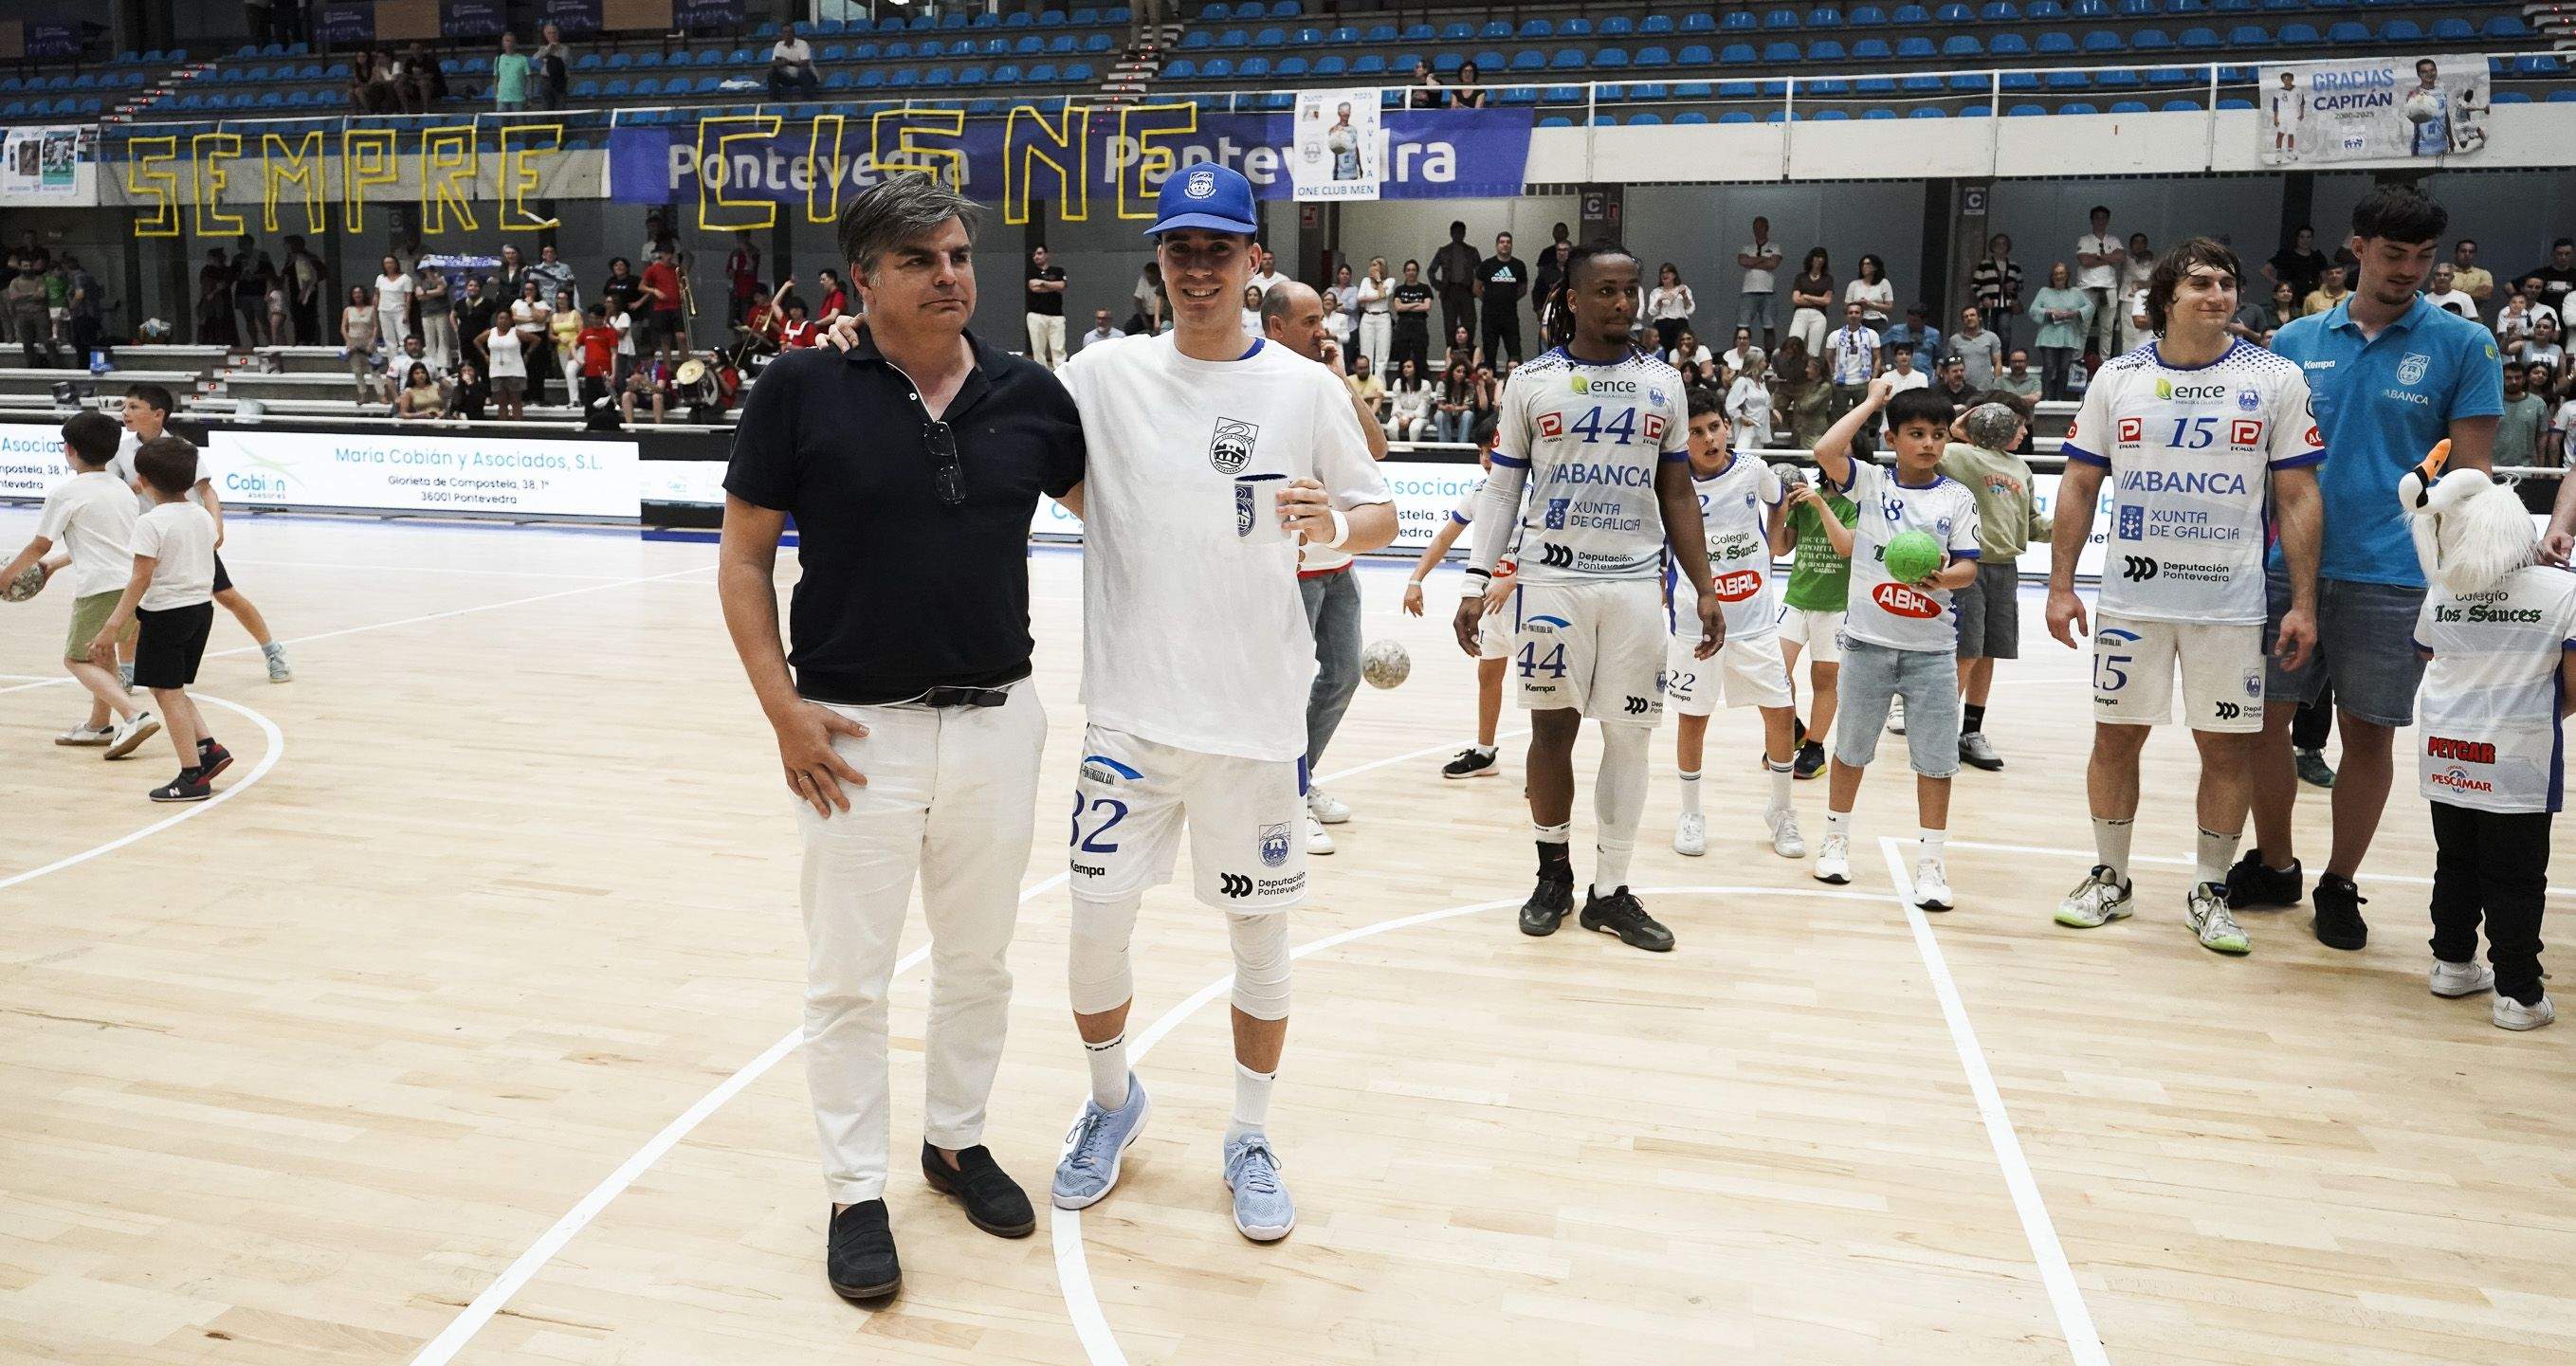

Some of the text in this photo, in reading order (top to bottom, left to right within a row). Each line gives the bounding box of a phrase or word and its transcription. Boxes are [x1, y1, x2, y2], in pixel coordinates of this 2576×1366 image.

[2312, 68, 2395, 92] GRACIAS
[2313, 88, 2393, 111] CAPITÁN
[127, 100, 1197, 237] SEMPRE CISNE
[1298, 184, 1374, 195] ONE CLUB MEN
[1525, 360, 1556, 375] Kempa
[2116, 360, 2147, 371] Kempa
[2304, 359, 2336, 370] Kempa
[1590, 379, 1636, 392] ence
[2175, 385, 2225, 398] ence
[2383, 390, 2429, 406] ABANCA
[1570, 406, 1635, 445] 44
[2165, 417, 2219, 449] 15
[336, 448, 603, 471] María Cobián y Asociados, S.L.
[227, 474, 285, 490] Cobin
[388, 476, 430, 487] Glorieta
[433, 478, 447, 486] de
[449, 478, 520, 490] Compostela,
[421, 491, 518, 504] 36001 Pontevedra
[1573, 501, 1620, 515] XUNTA
[1571, 515, 1641, 530] DE GALICIA
[2150, 510, 2208, 522] XUNTA
[1710, 531, 1749, 545] Colegio
[2149, 525, 2239, 539] DE GALICIA
[1579, 552, 1635, 562] Deputación
[2164, 561, 2229, 574] Deputación
[2164, 572, 2229, 582] Pontevedra
[2434, 604, 2542, 623] Los Sauces
[1518, 641, 1567, 679] 44
[2092, 653, 2133, 691] 15
[1666, 669, 1696, 692] 22
[1525, 683, 1556, 694] Kempa
[2431, 773, 2493, 792] PESCAMAR
[1070, 858, 1105, 878] Kempa
[1258, 871, 1306, 889] Deputación
